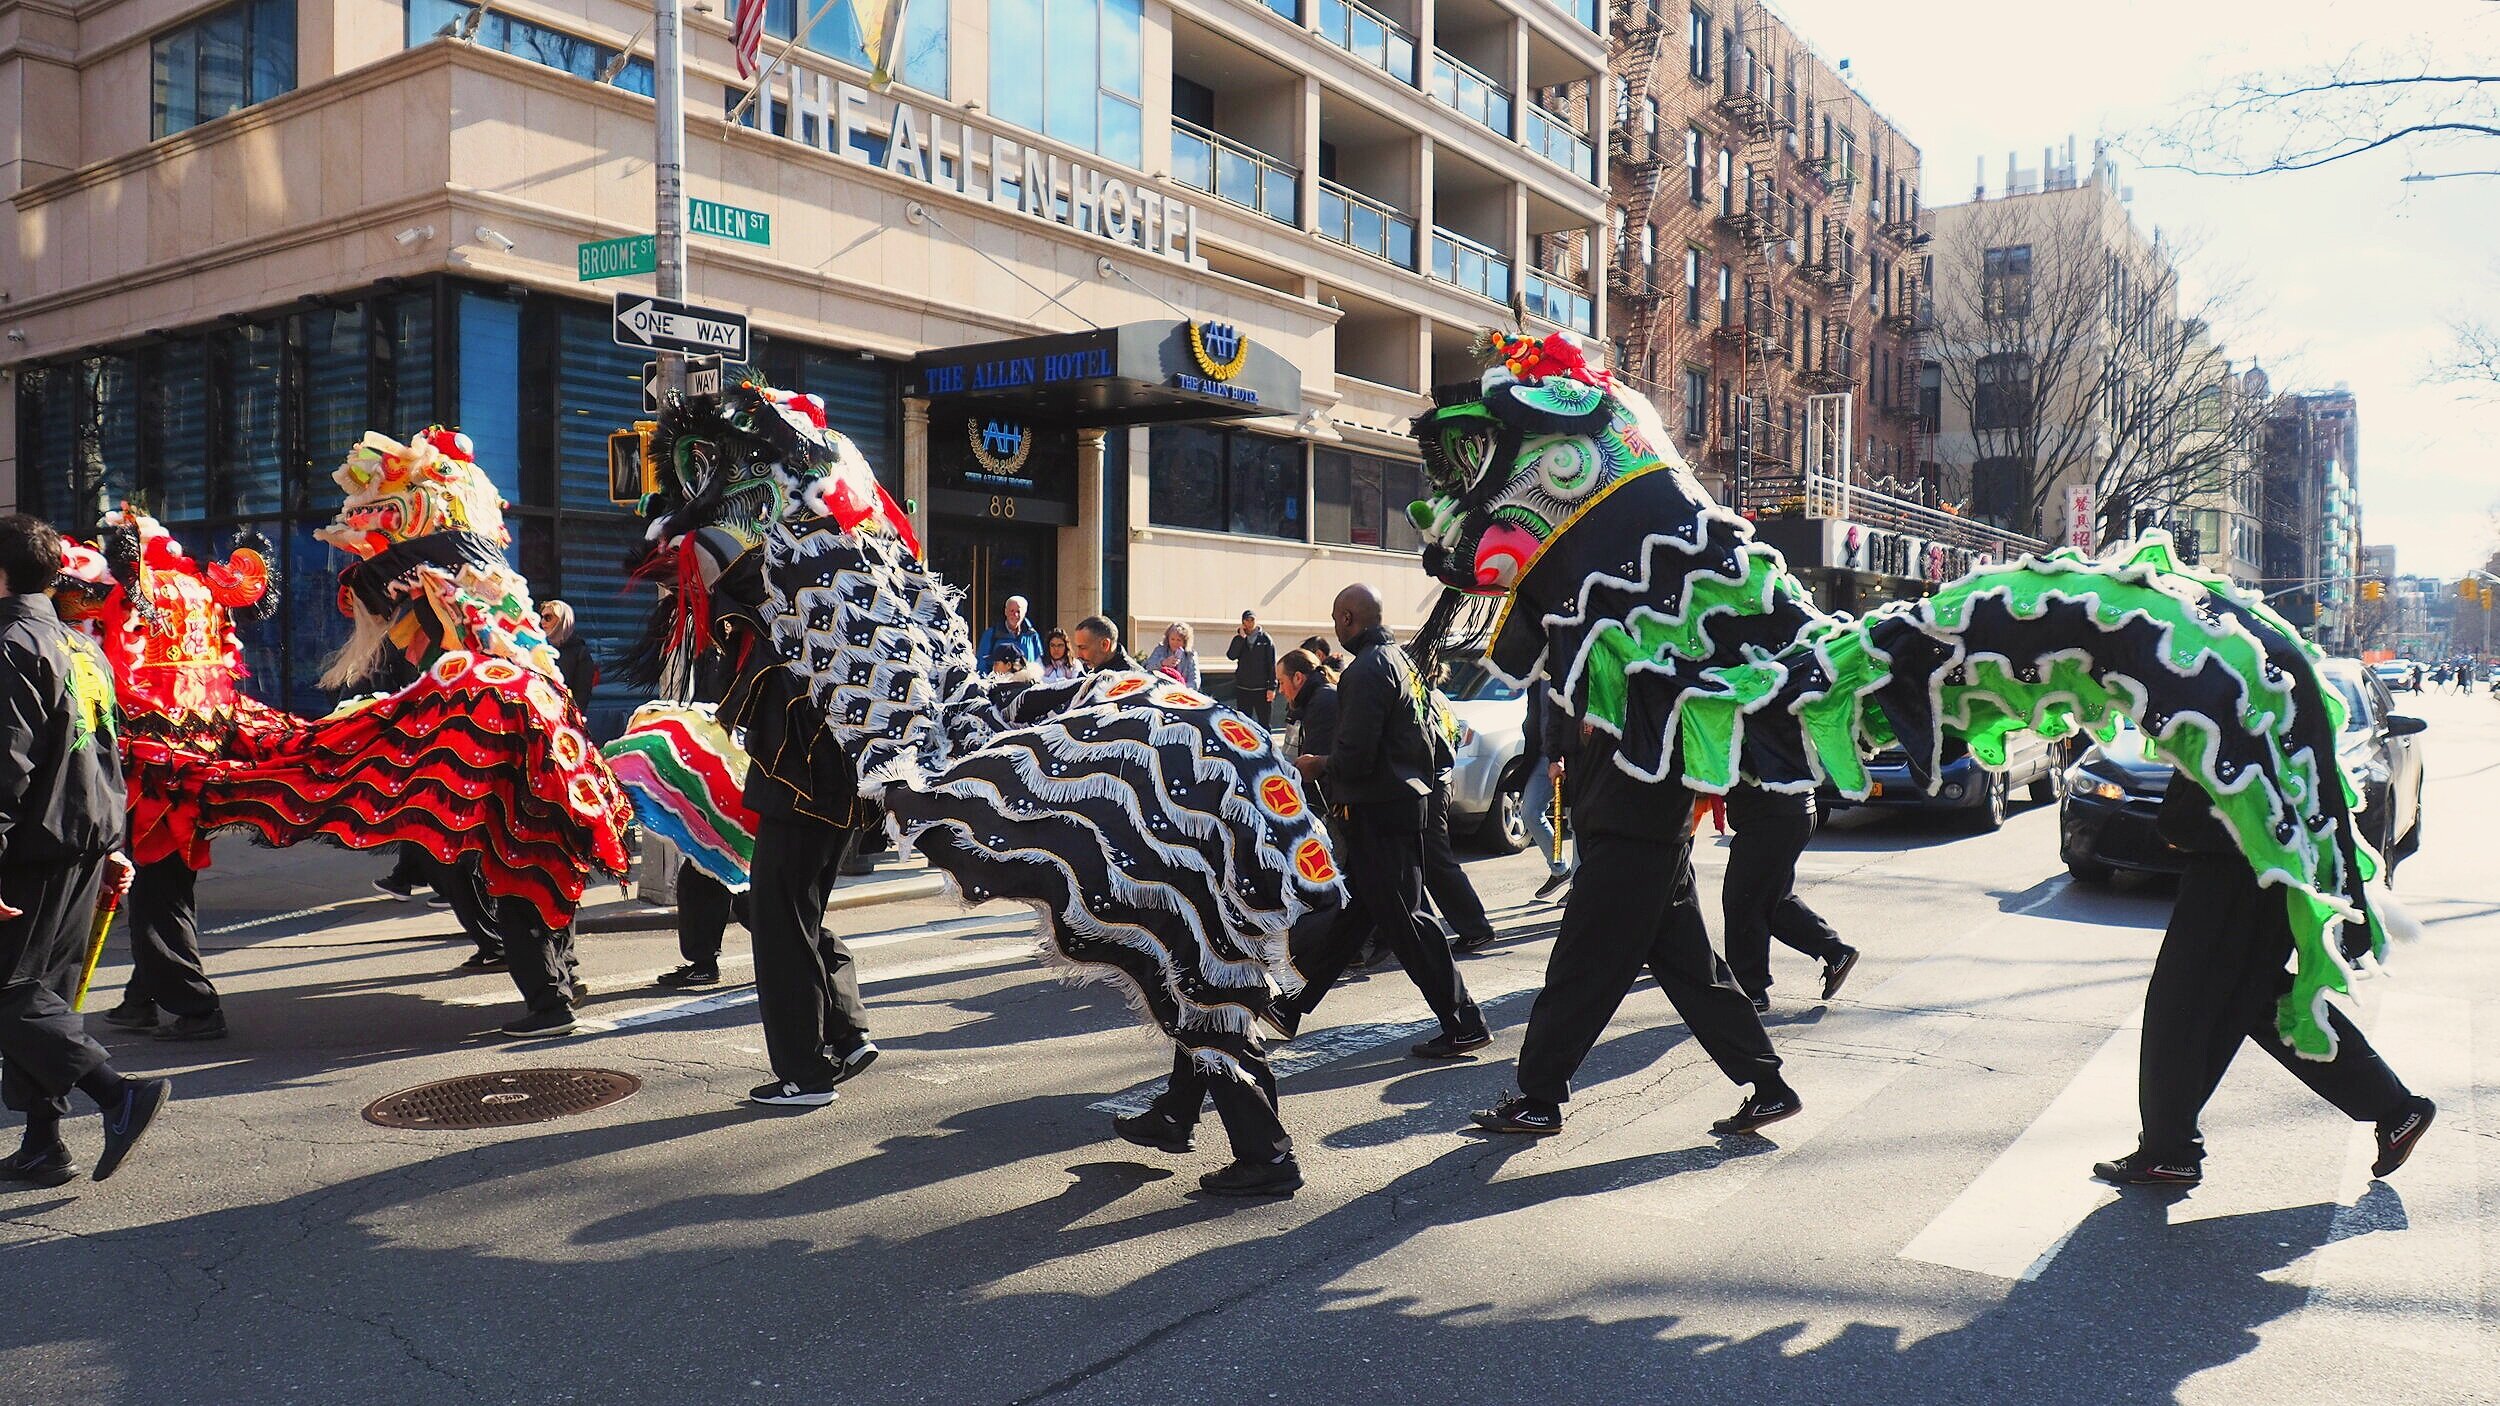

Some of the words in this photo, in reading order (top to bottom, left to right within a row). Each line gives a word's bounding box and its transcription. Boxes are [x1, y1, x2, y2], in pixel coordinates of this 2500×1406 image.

[757, 53, 870, 165] THE
[884, 102, 1057, 222] ALLEN
[1071, 162, 1208, 271] HOTEL
[692, 202, 746, 239] ALLEN
[750, 213, 765, 229] ST
[582, 241, 637, 275] BROOME
[641, 238, 653, 254] ST
[634, 311, 674, 335] ONE
[696, 321, 735, 344] WAY
[1204, 320, 1238, 358] AH
[695, 371, 715, 393] WAY
[925, 364, 966, 394] THE
[972, 357, 1036, 391] ALLEN
[1043, 348, 1112, 383] HOTEL
[1180, 374, 1200, 391] THE
[1201, 379, 1229, 397] ALLEN
[1231, 384, 1259, 405] HOTEL
[983, 420, 1021, 455] AH
[990, 495, 1015, 518] 88
